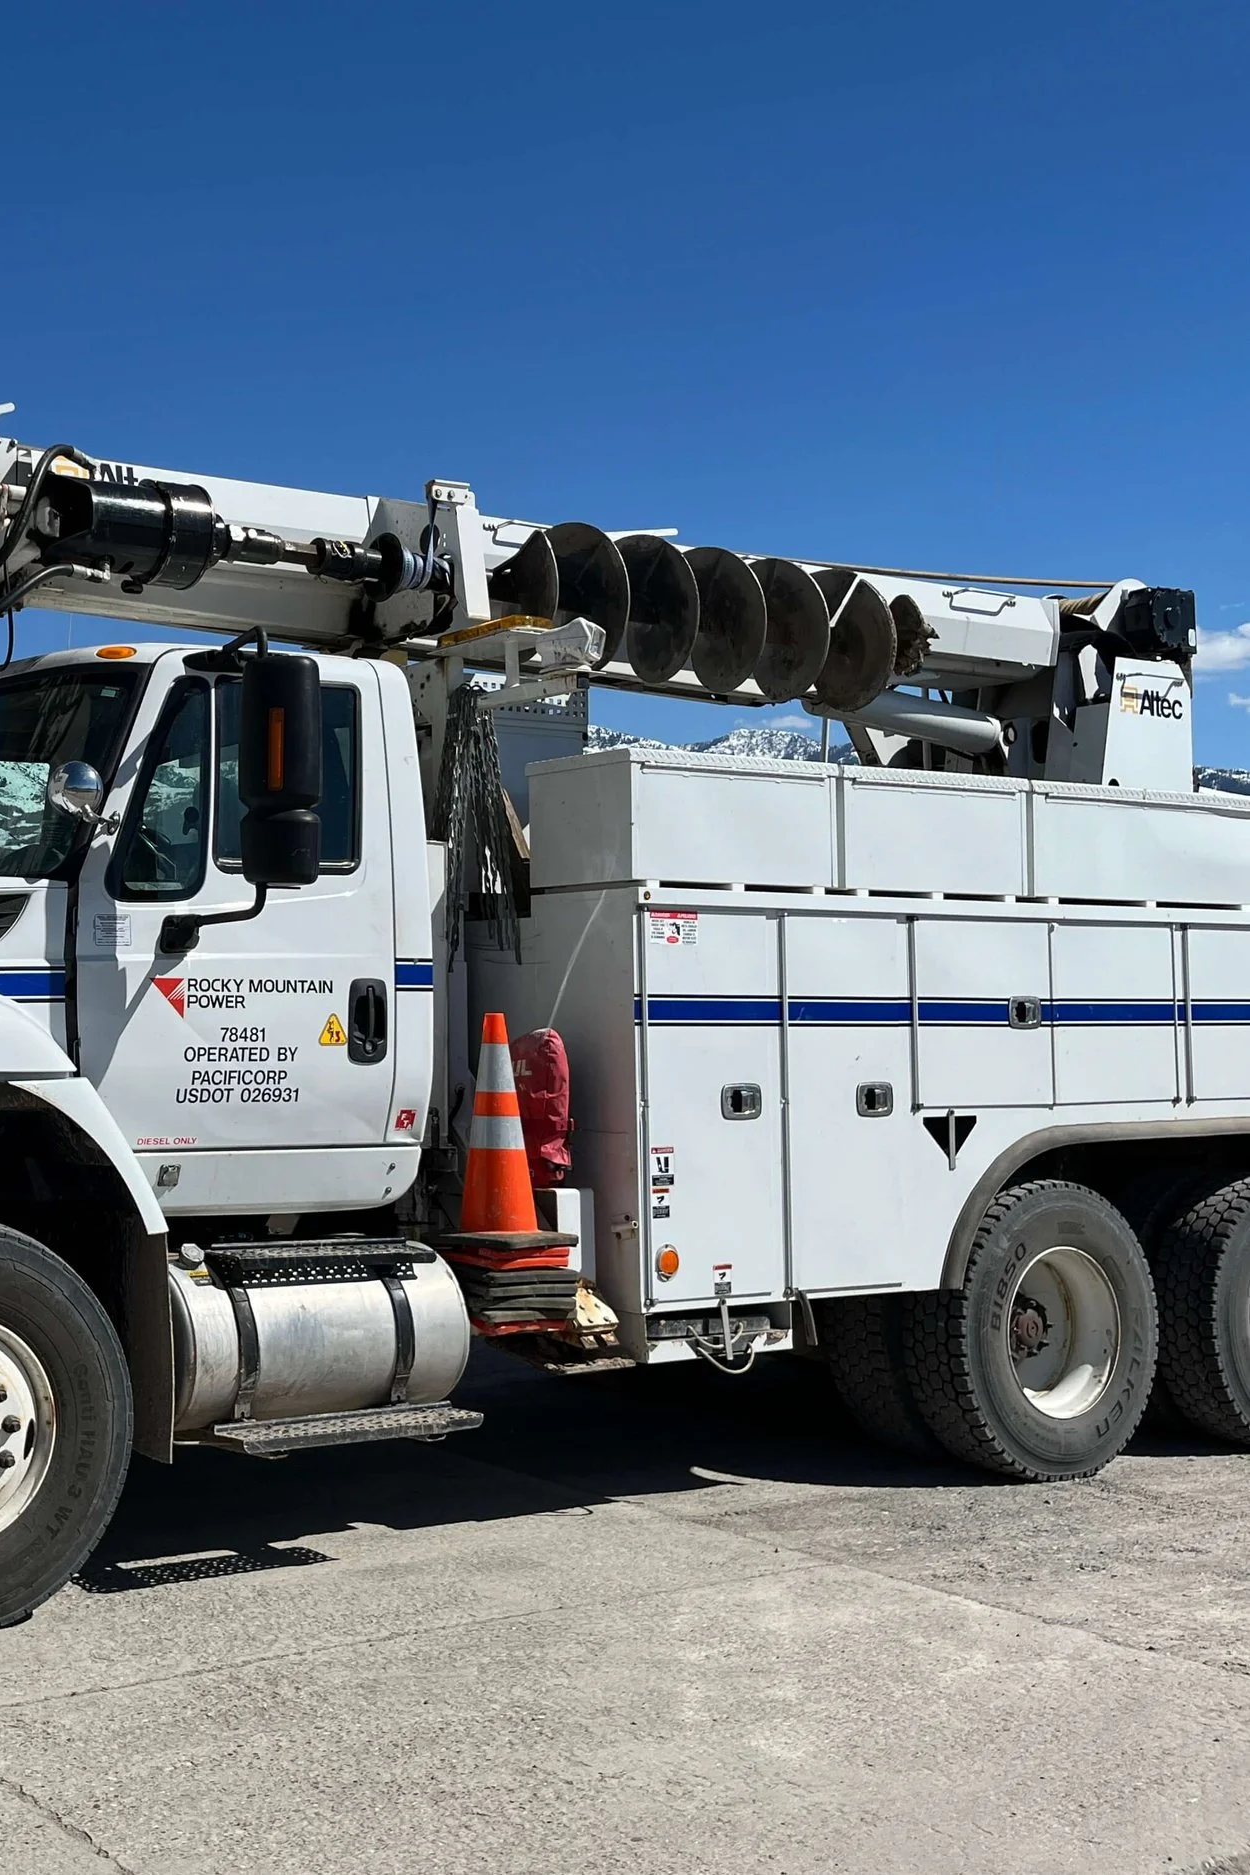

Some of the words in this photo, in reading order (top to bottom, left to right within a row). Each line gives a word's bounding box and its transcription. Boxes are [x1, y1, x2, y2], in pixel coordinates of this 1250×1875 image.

[1139, 689, 1183, 720] Altec
[187, 978, 244, 992] ROCKY
[249, 979, 333, 994] MOUNTAIN
[187, 994, 246, 1008] POWER
[220, 1027, 266, 1042] 78481
[184, 1046, 270, 1062] OPERATED
[277, 1046, 298, 1062] BY
[191, 1070, 288, 1085] PACIFICORP
[176, 1088, 234, 1103] USDOT
[240, 1087, 299, 1103] 026931
[137, 1137, 170, 1146] DIESEL
[173, 1136, 198, 1145] ONLY
